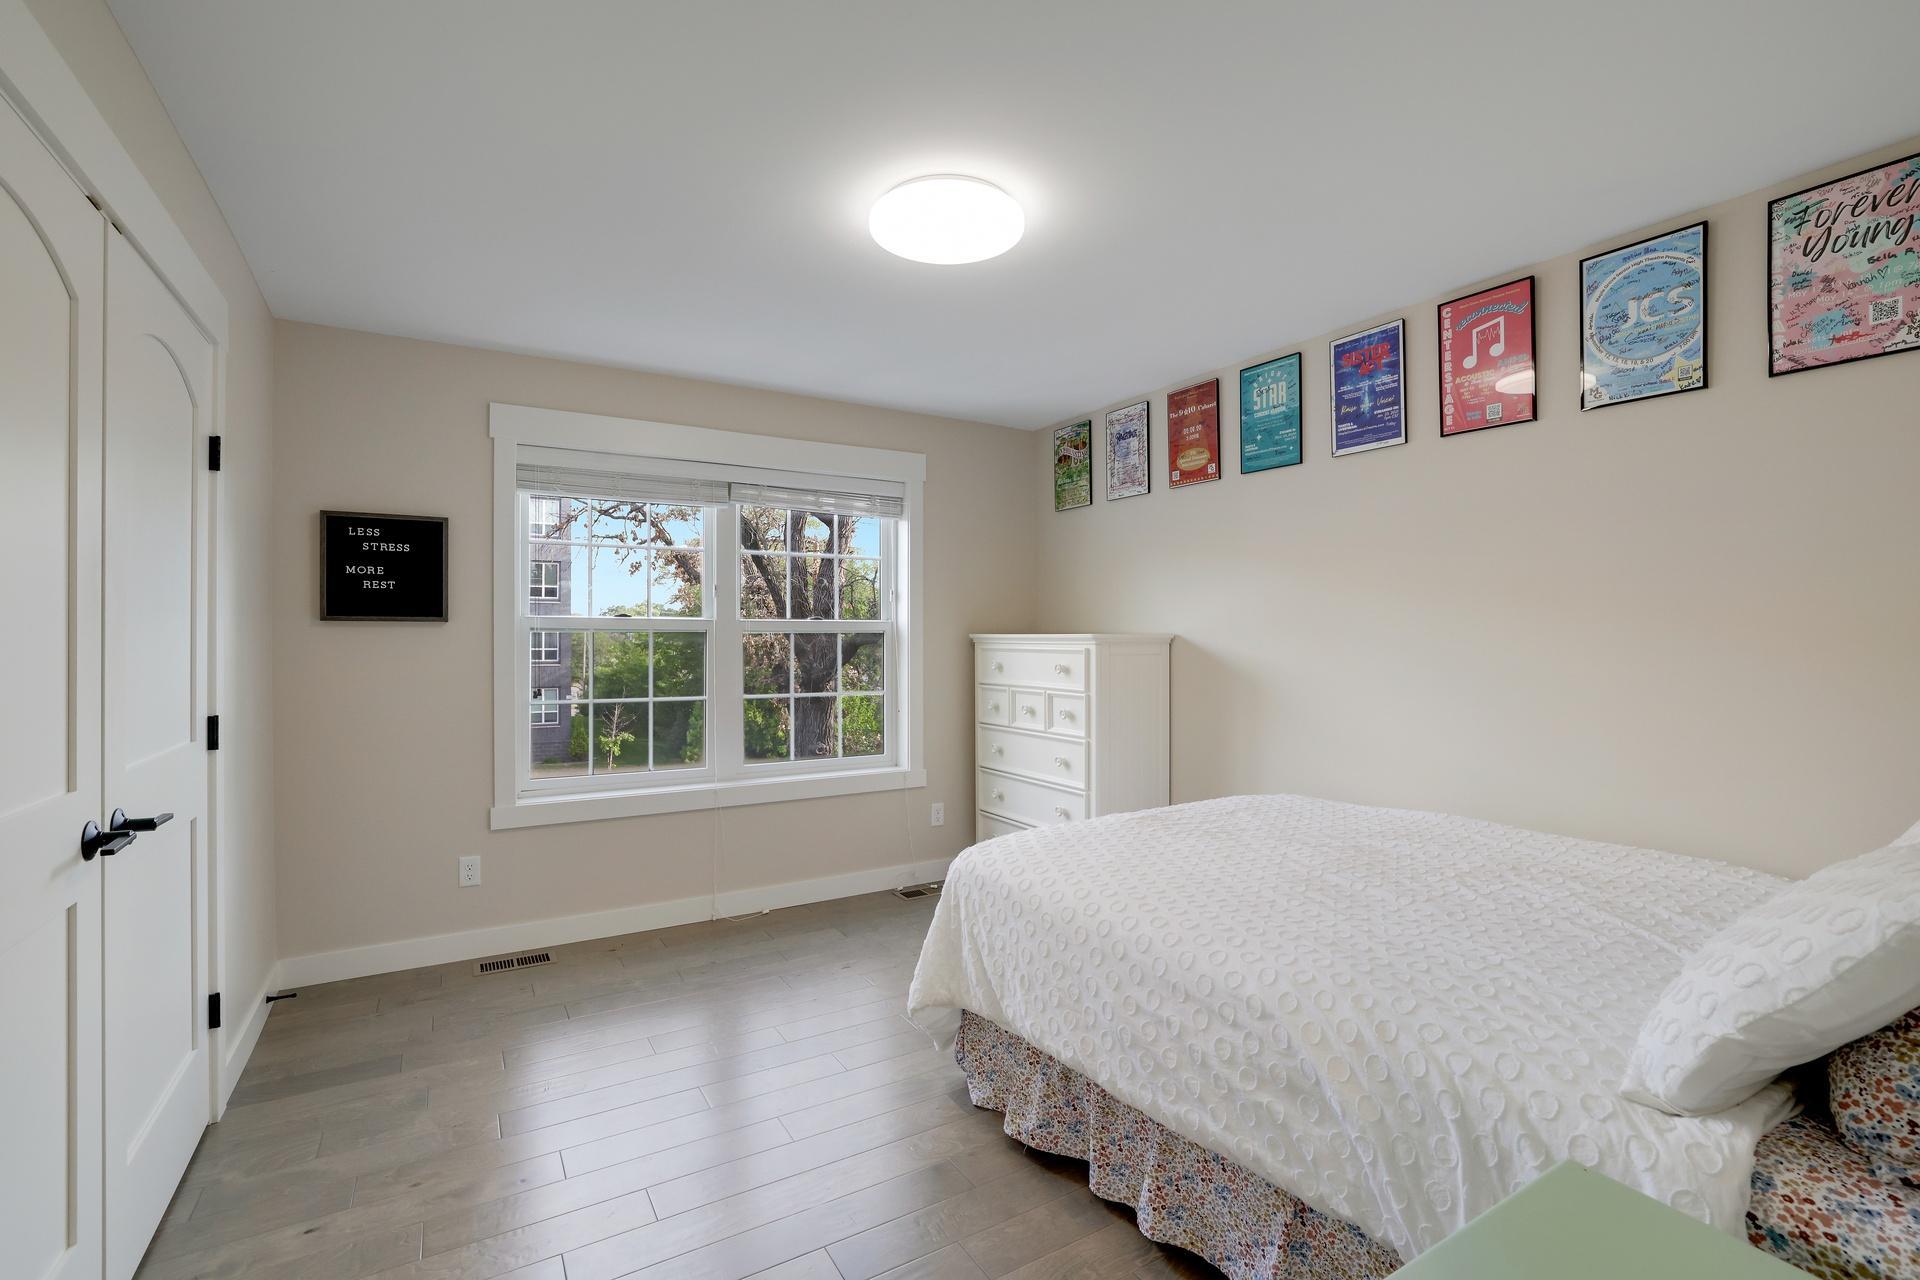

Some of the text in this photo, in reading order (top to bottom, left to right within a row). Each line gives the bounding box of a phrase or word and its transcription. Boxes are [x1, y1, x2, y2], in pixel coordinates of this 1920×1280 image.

[1792, 178, 1920, 236] Forever
[1621, 284, 1695, 328] JCS
[1343, 343, 1391, 368] SISTER
[1253, 381, 1287, 410] STAR
[348, 527, 380, 536] LESS
[362, 542, 410, 552] STRESS
[345, 565, 384, 575] MORE
[362, 580, 396, 589] REST
